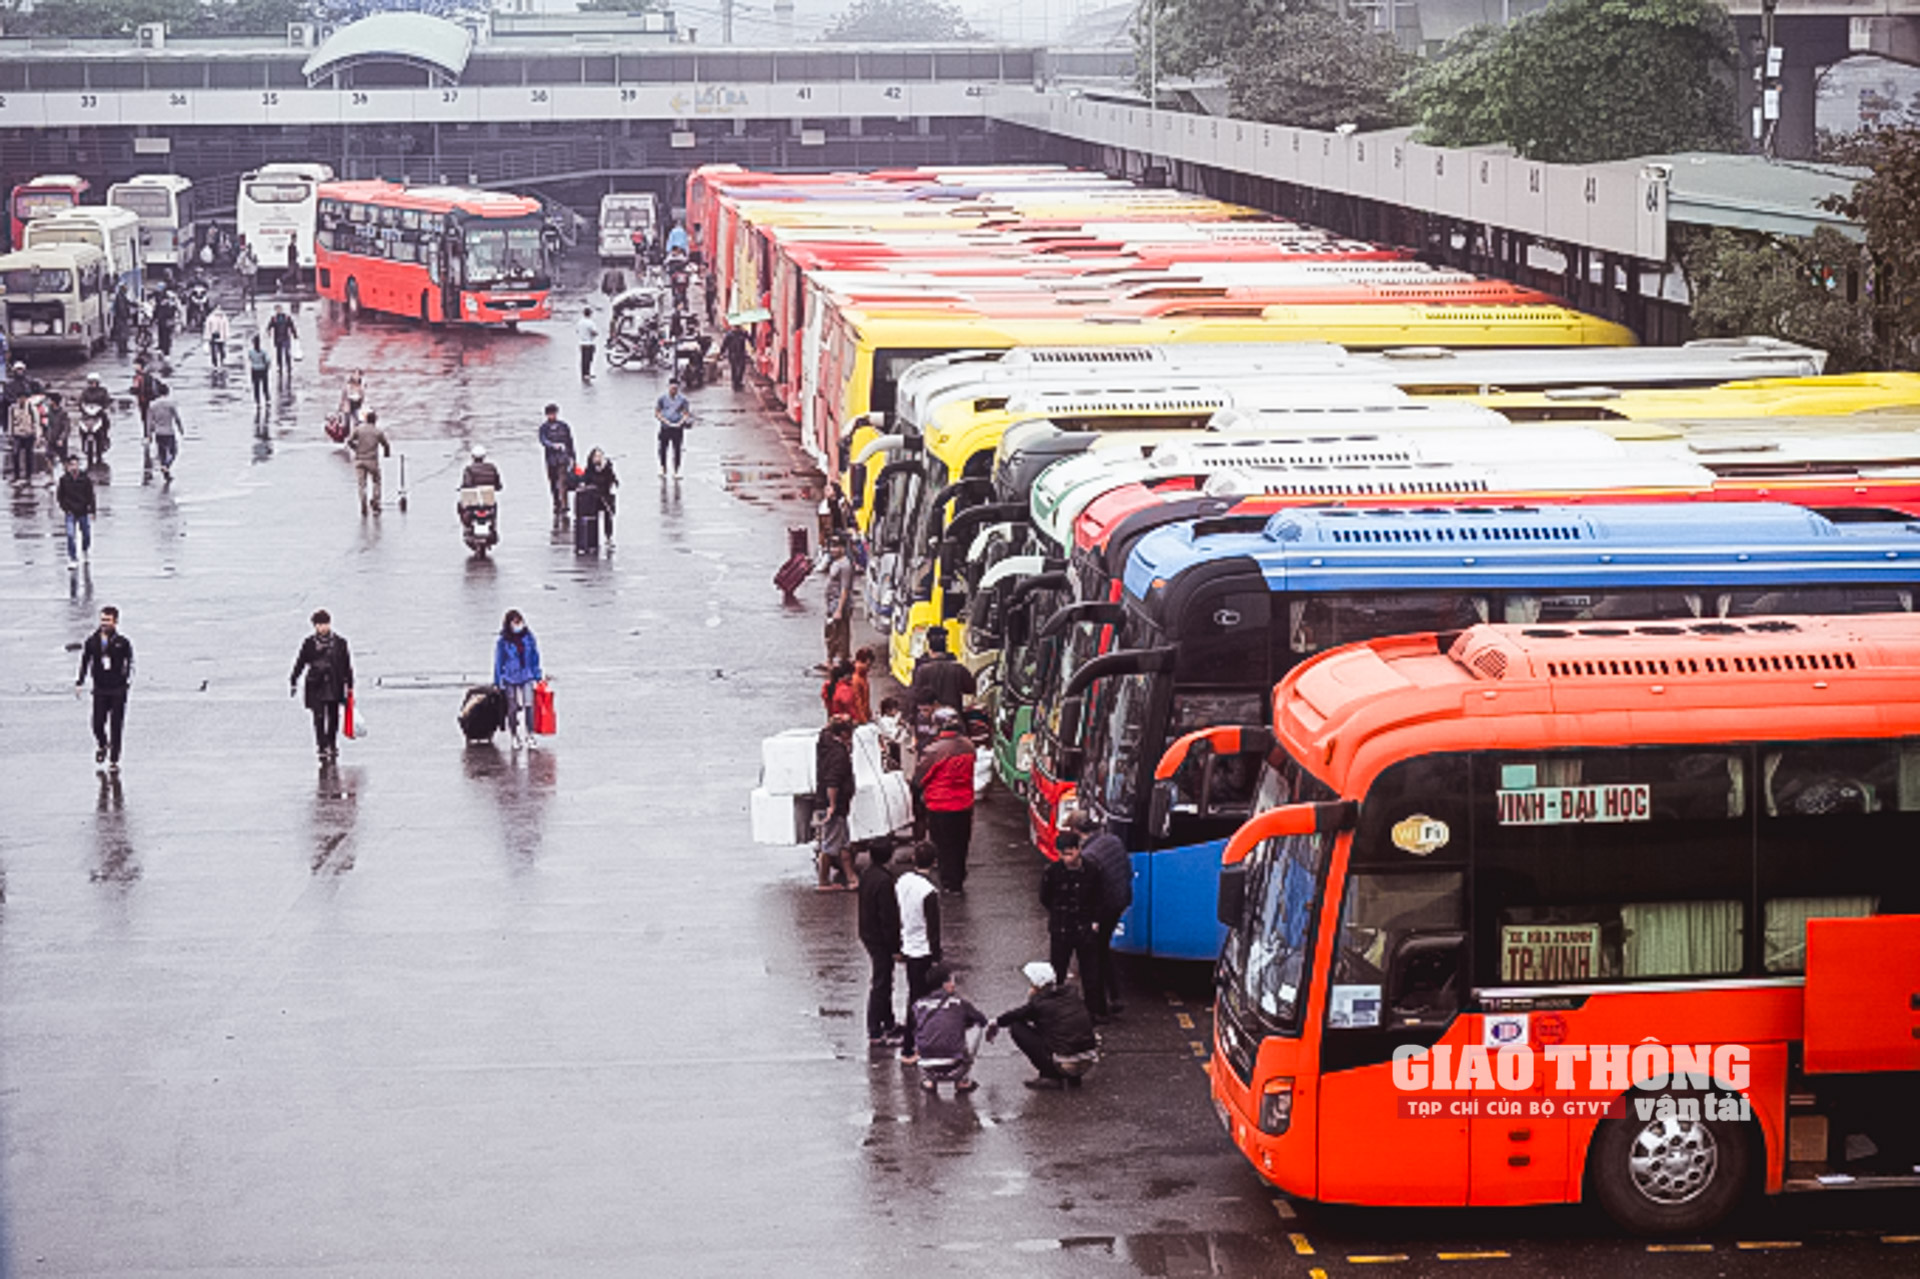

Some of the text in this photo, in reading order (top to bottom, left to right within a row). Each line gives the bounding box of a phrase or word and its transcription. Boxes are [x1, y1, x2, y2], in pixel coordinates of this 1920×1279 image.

[796, 87, 812, 99] 41
[884, 87, 901, 99] 42
[81, 95, 97, 108] 33
[1604, 787, 1647, 823] HỌC
